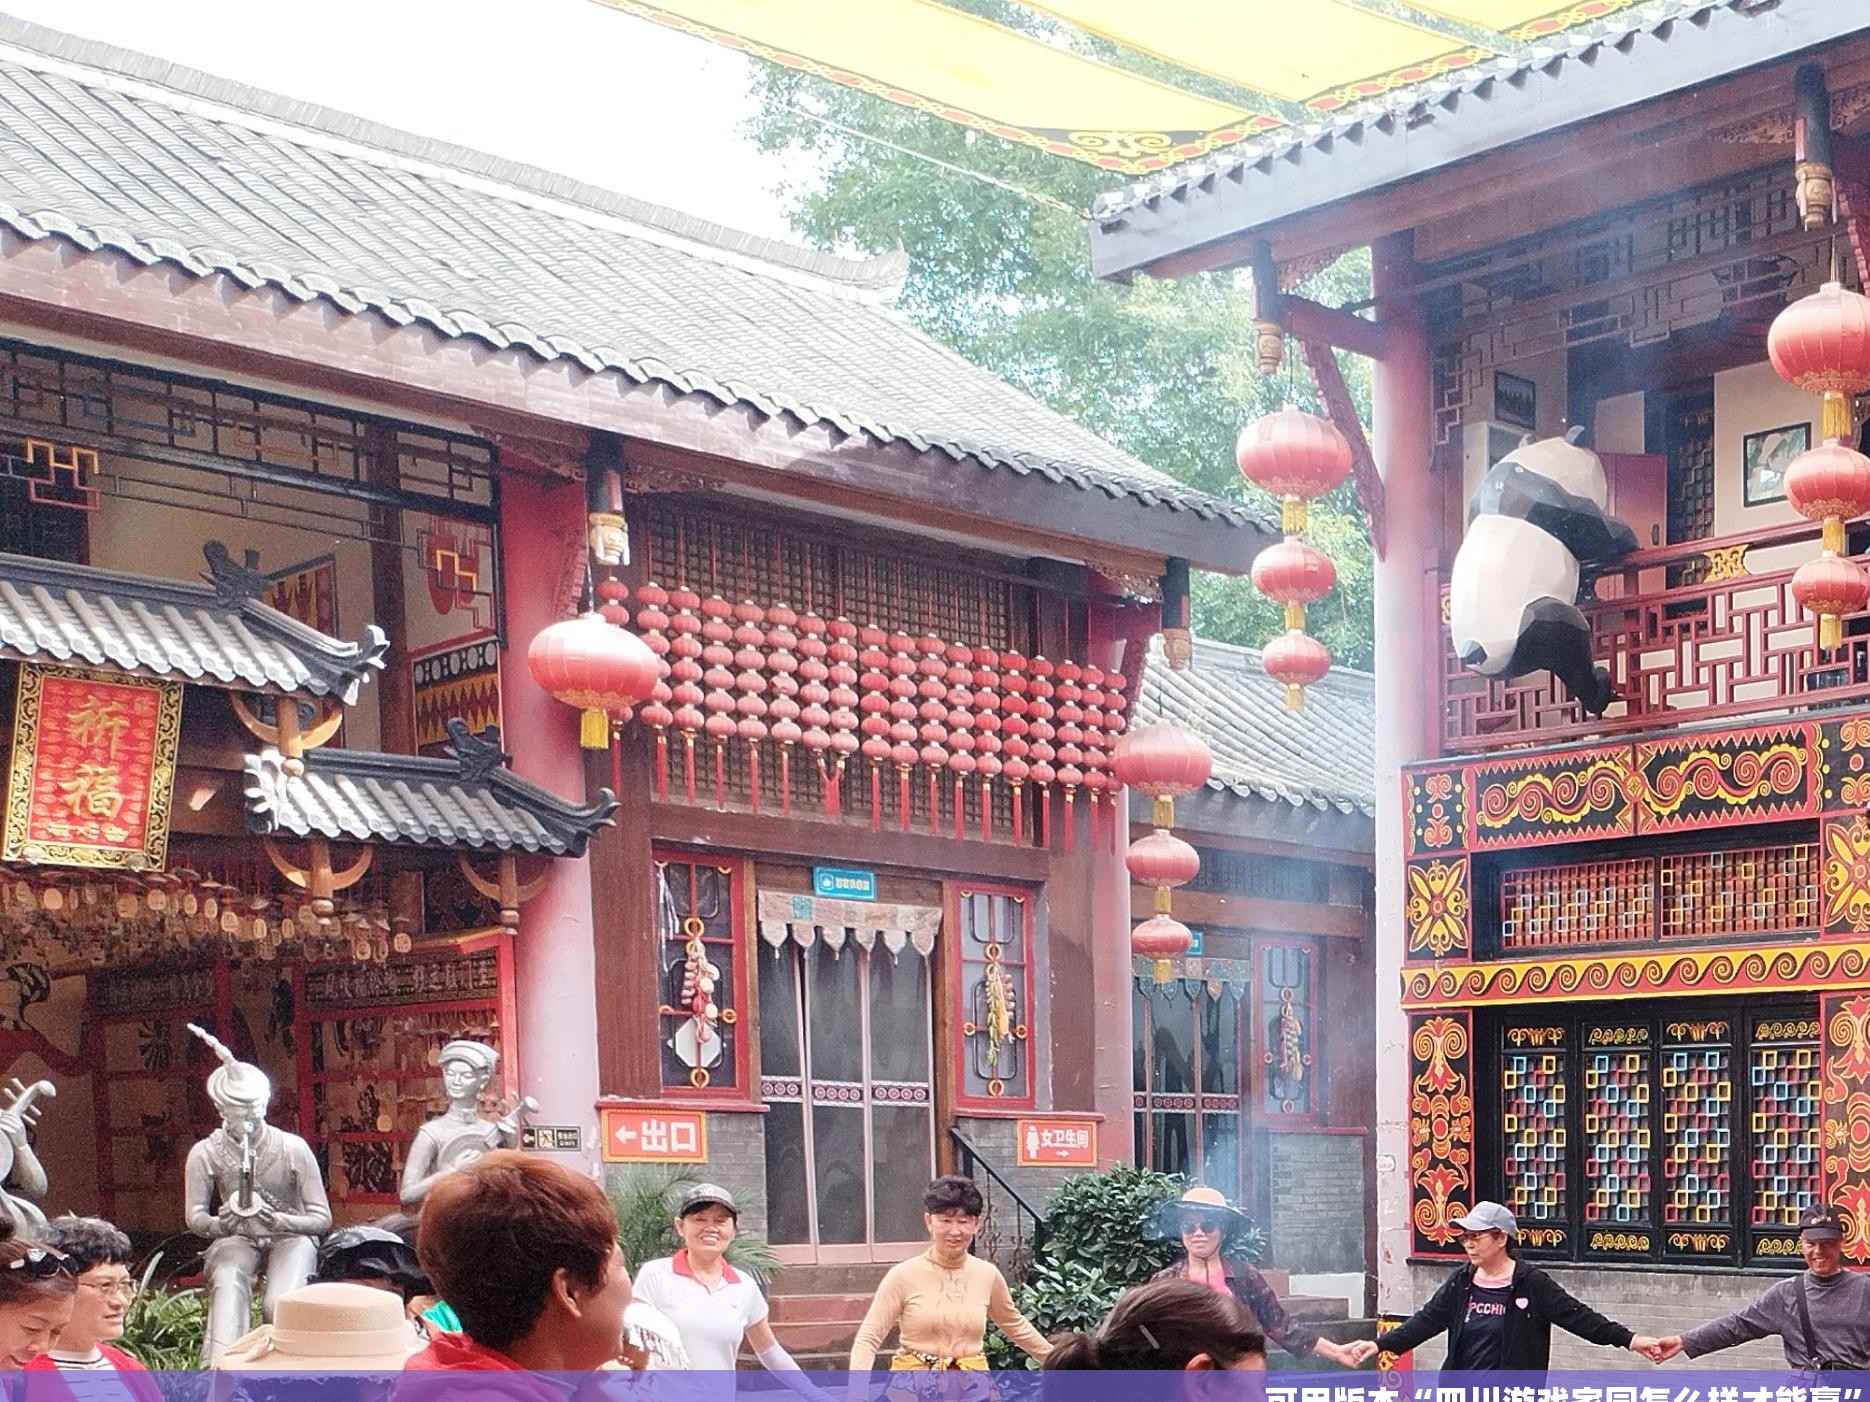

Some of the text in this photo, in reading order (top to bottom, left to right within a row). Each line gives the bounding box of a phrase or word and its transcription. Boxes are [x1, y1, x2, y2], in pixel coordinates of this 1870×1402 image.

[58, 694, 131, 821] 祈福
[641, 1118, 696, 1152] 出口
[1041, 1128, 1089, 1149] 女卫生间
